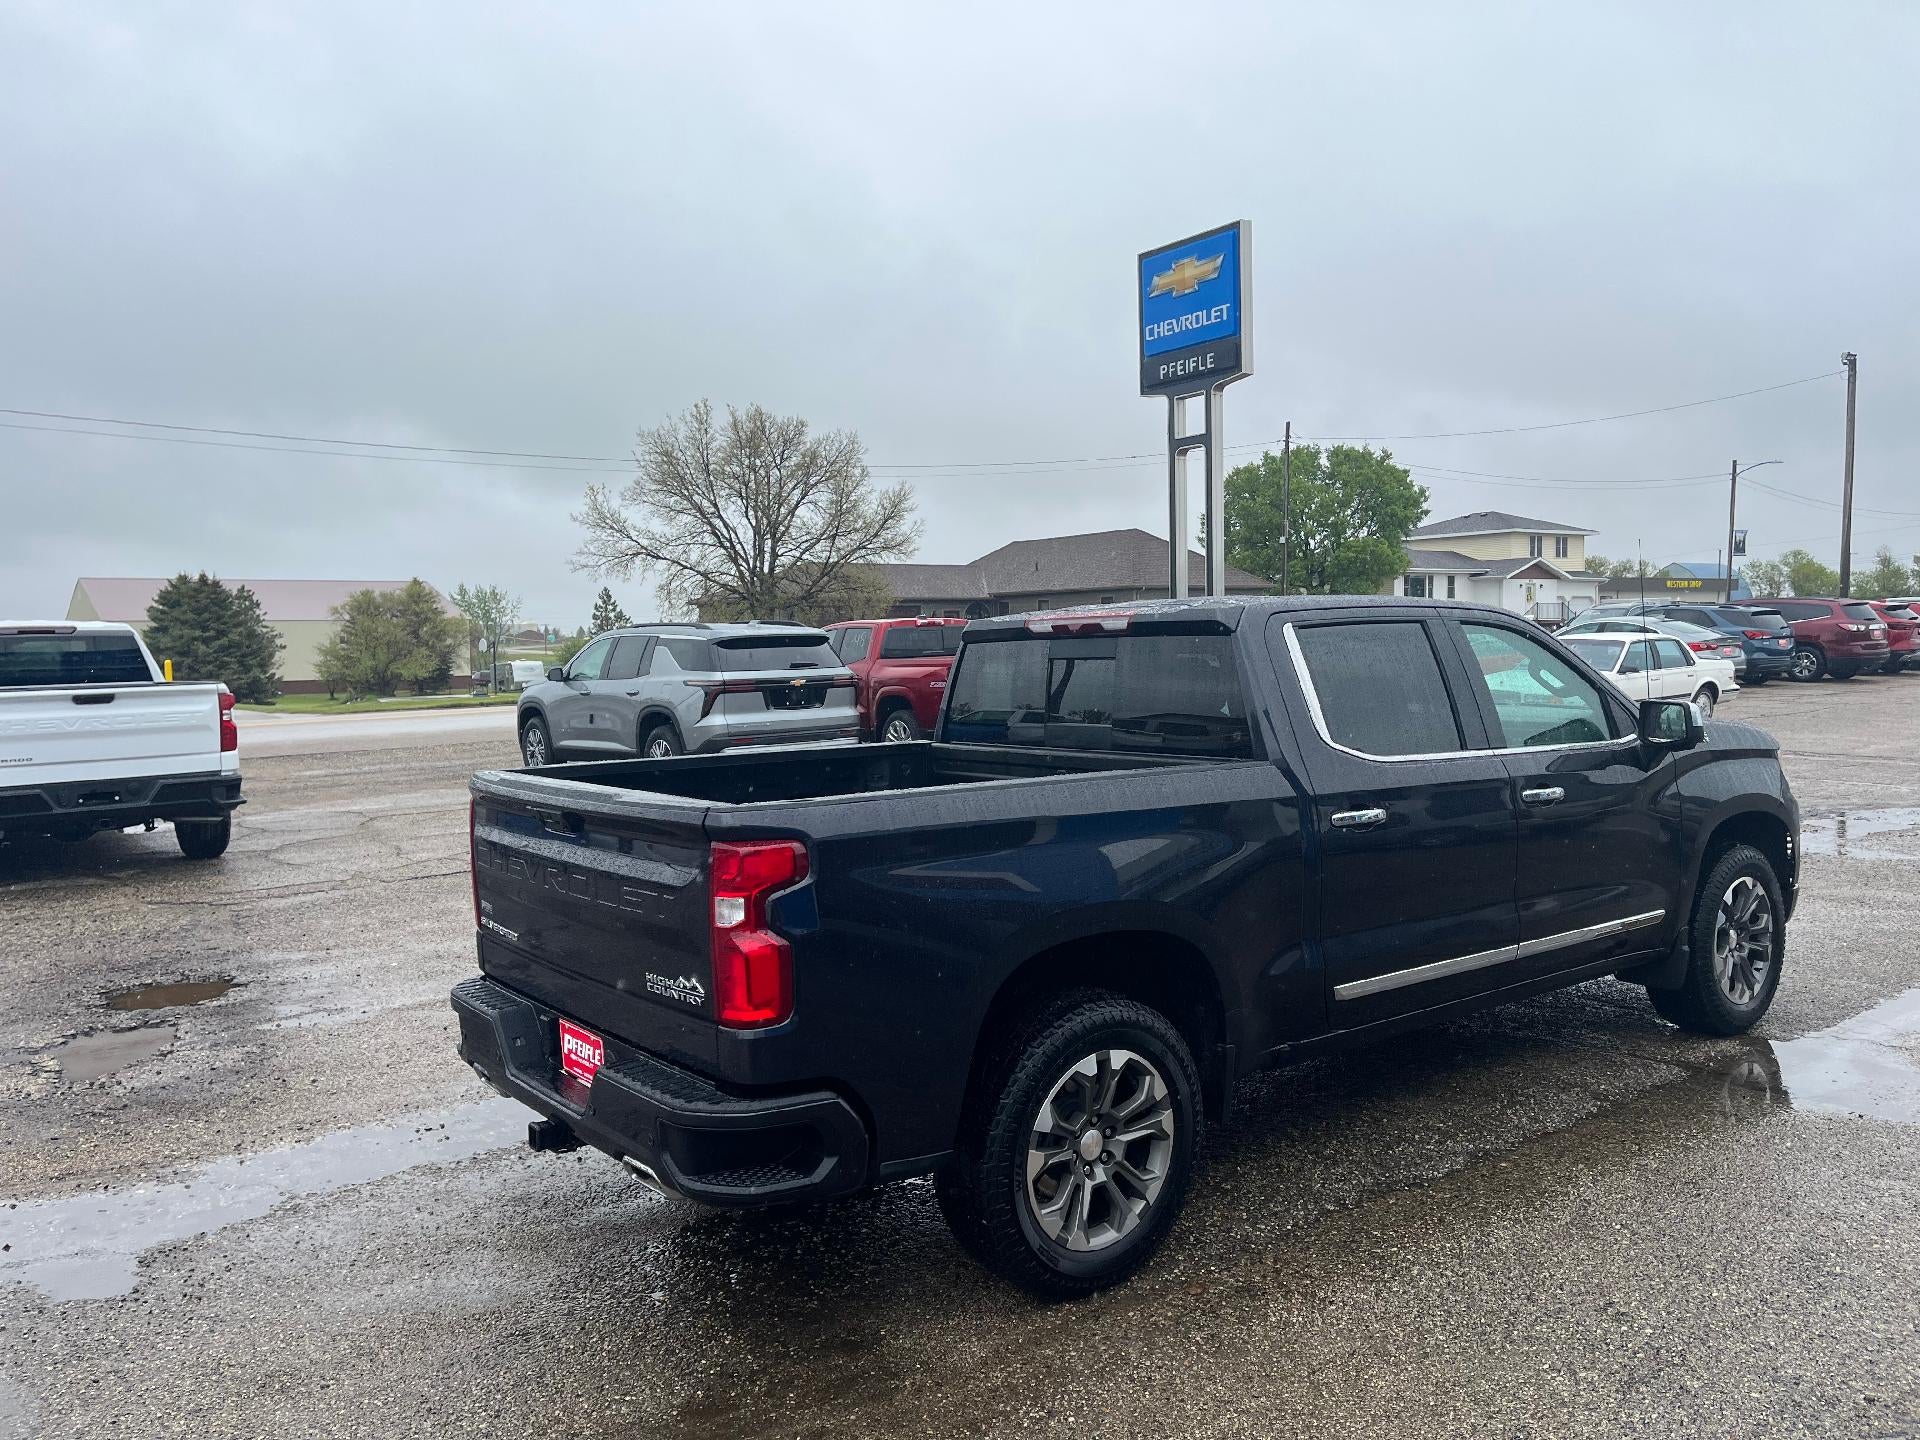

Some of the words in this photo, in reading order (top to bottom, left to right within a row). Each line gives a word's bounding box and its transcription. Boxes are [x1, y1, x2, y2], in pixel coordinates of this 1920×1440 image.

[1145, 303, 1230, 341] CHEVROLET
[1159, 352, 1215, 380] PFEIFLE
[0, 711, 206, 734] HEVROLET
[477, 846, 677, 919] CHEVROLET
[645, 972, 674, 989] HIGH
[646, 982, 705, 1006] COUNTRY
[563, 1033, 601, 1066] PFEIFLE
